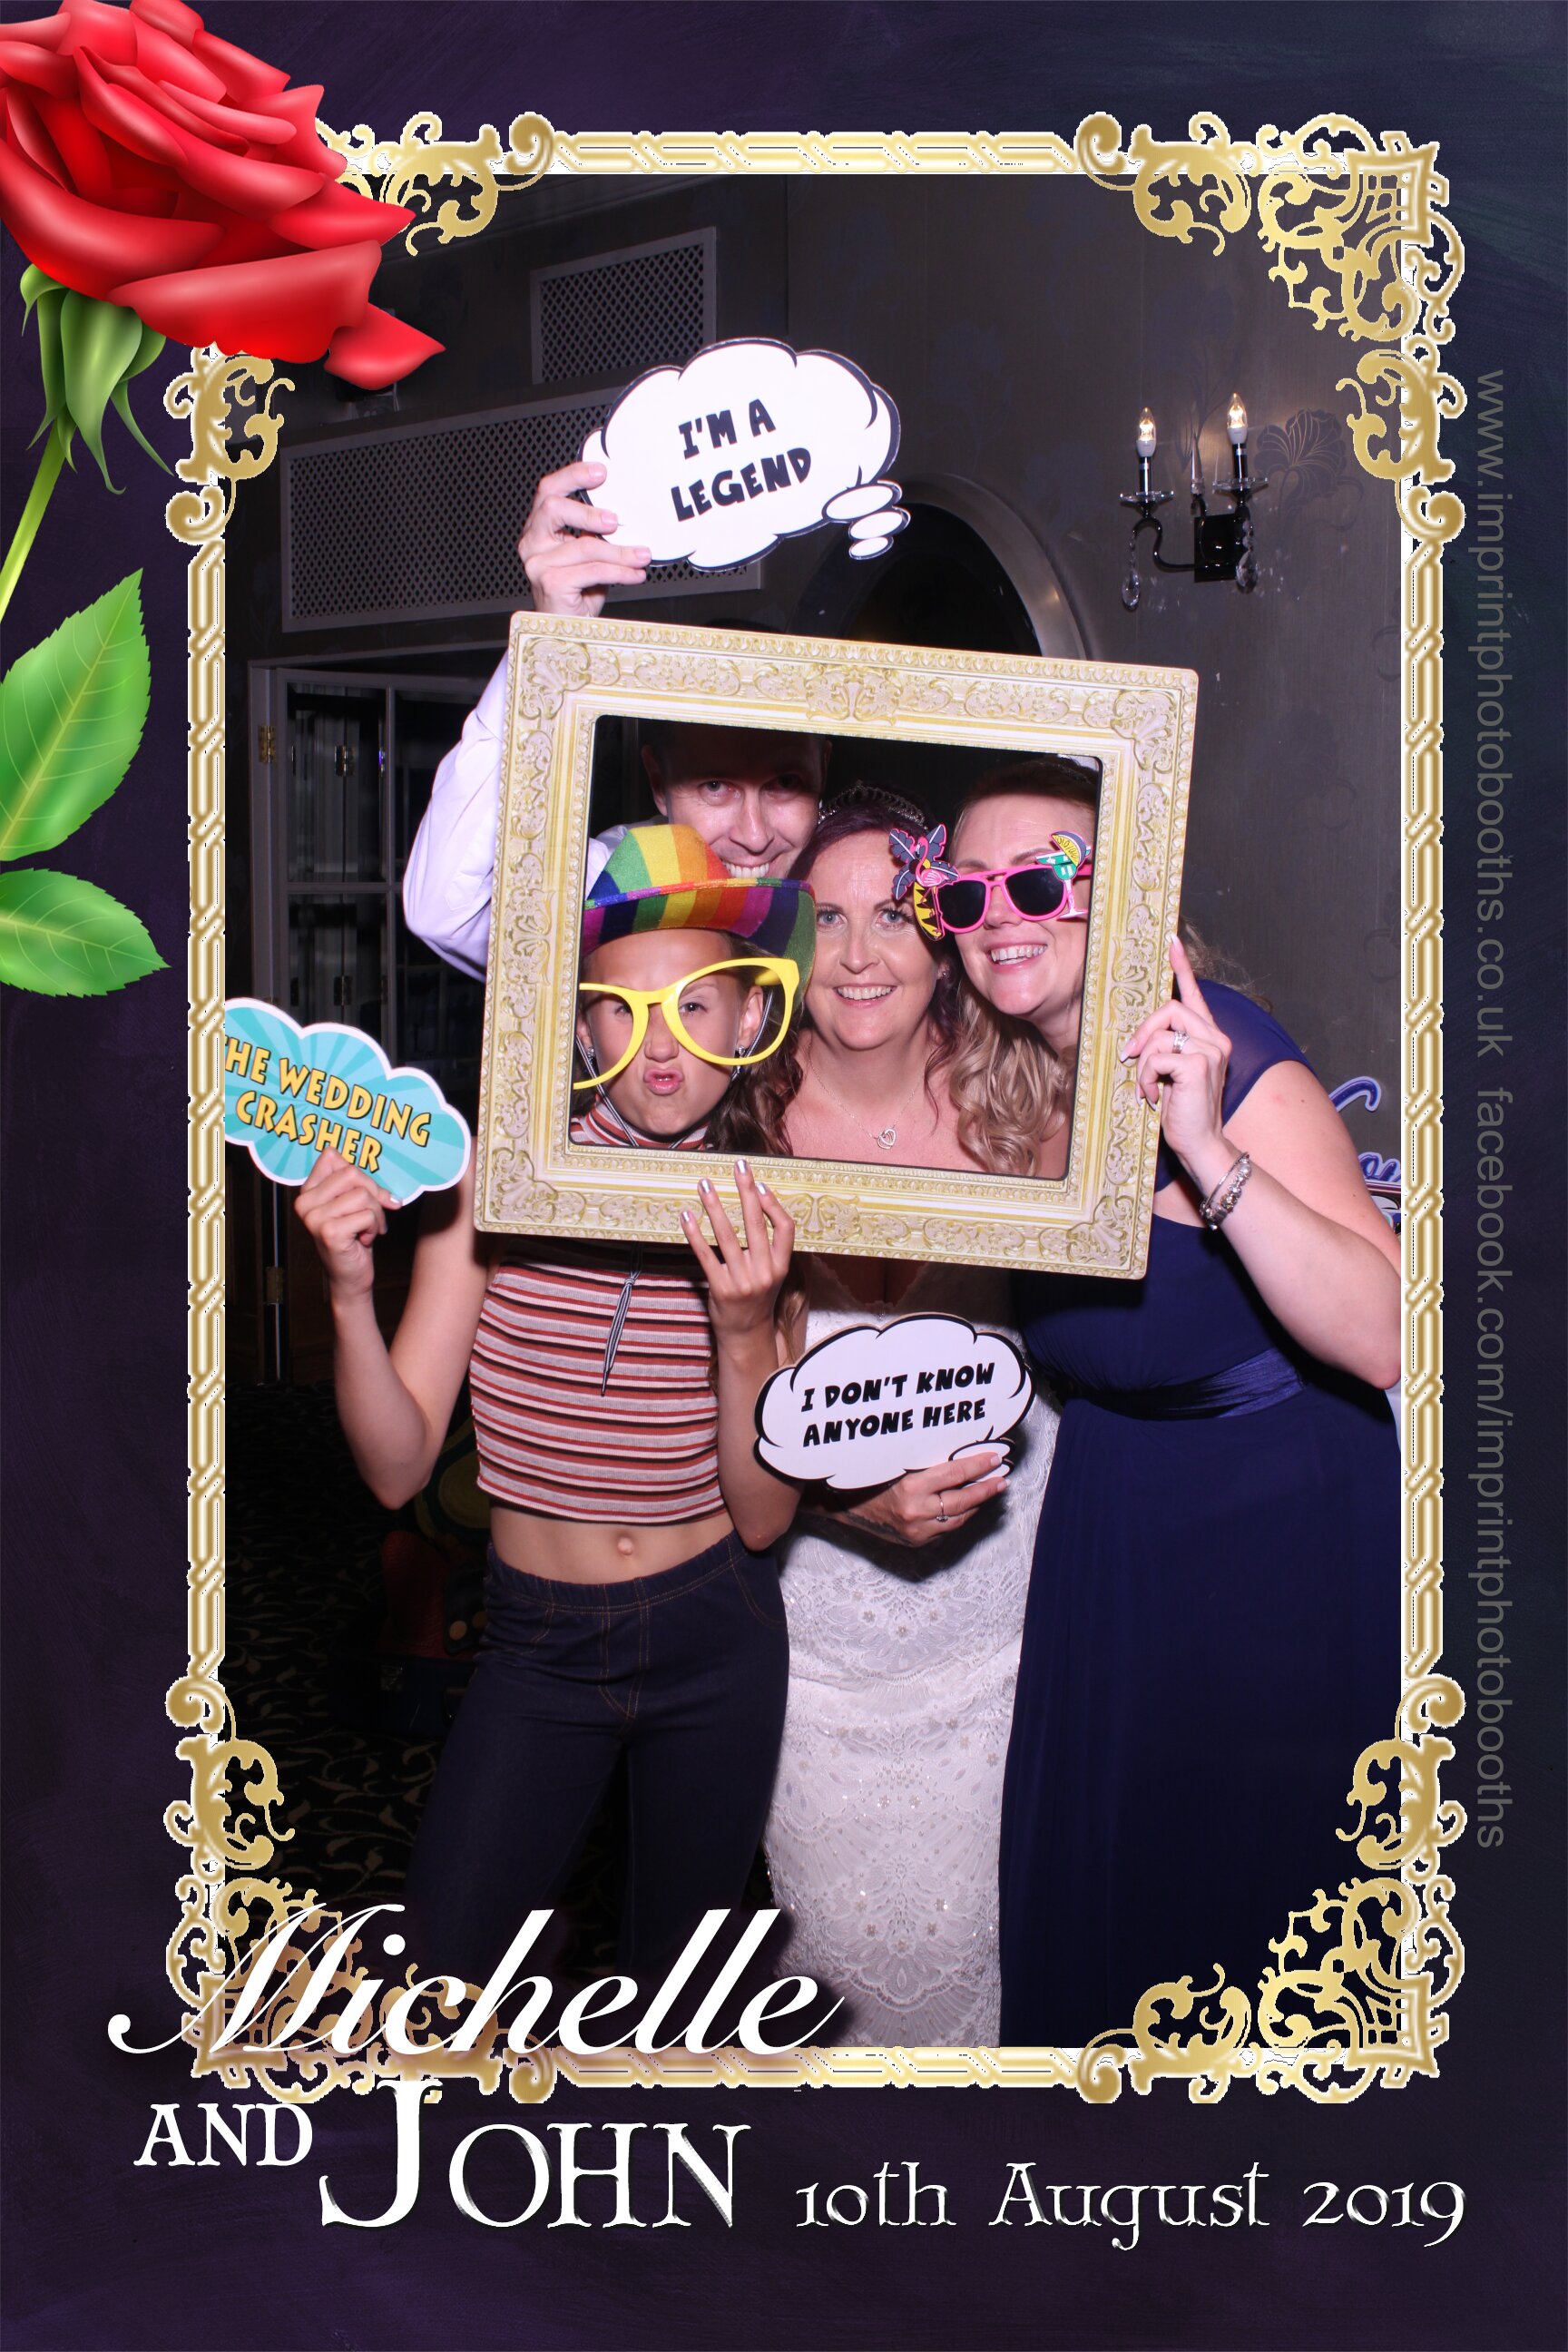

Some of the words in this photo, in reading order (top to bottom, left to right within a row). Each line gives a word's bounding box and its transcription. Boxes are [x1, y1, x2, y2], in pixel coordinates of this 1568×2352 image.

[678, 408, 738, 460] I'M
[749, 398, 777, 437] A
[671, 447, 811, 523] LEGEND
[225, 1034, 271, 1085] HE
[279, 1057, 432, 1148] WEDDING
[235, 1090, 383, 1173] CRASHER
[800, 1387, 816, 1413] I
[824, 1373, 908, 1409] DON'T
[916, 1362, 995, 1395] KNOW
[802, 1408, 914, 1448] ANYONE
[922, 1397, 986, 1429] HERE
